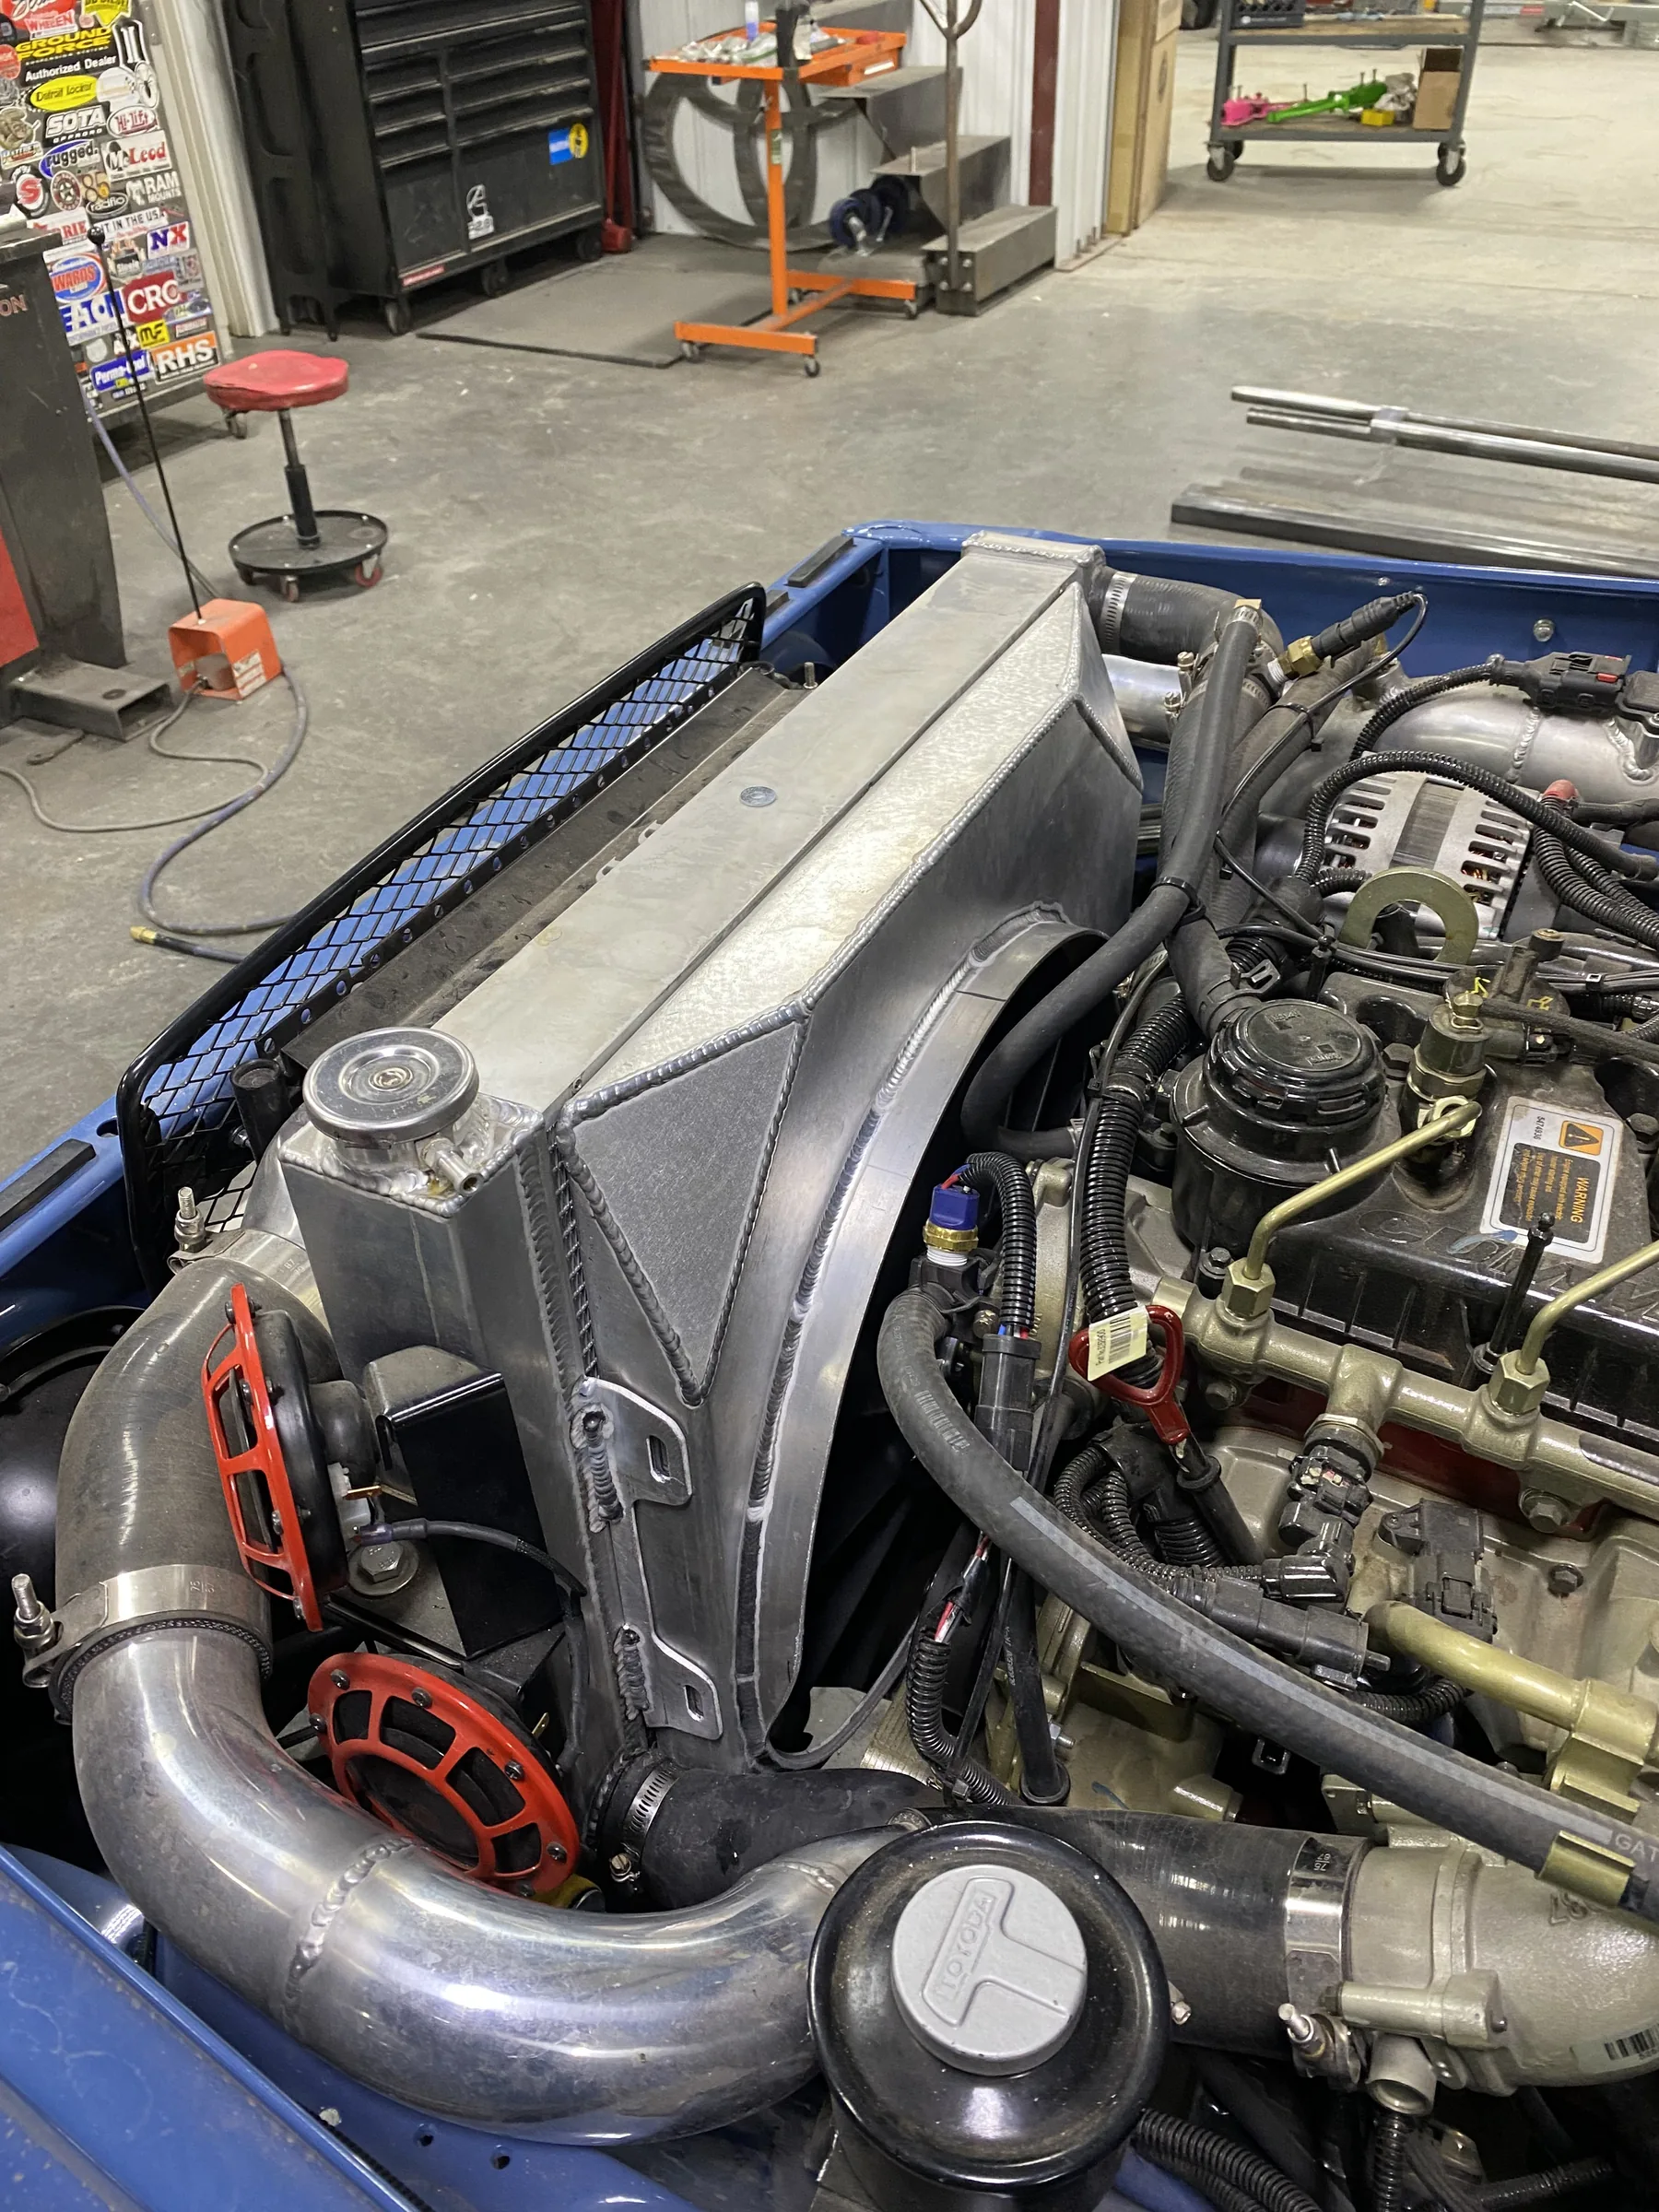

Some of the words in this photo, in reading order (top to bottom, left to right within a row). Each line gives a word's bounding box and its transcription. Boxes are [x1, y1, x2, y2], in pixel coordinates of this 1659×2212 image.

[16, 27, 112, 53] GROUND
[17, 35, 112, 62] FORCE
[26, 60, 81, 83] Authorized
[84, 55, 117, 70] Dealer
[66, 82, 93, 96] Locker
[46, 107, 107, 137] SOTA
[144, 171, 180, 194] RAM
[147, 187, 182, 203] MOUNTS
[113, 218, 123, 231] IN
[125, 212, 144, 228] THE
[146, 208, 165, 222] USA
[150, 223, 187, 251] NX
[127, 279, 180, 314] CRC
[156, 338, 214, 375] RHS
[1570, 1177, 1590, 1224] WARNING
[1313, 1863, 1327, 1872] 75
